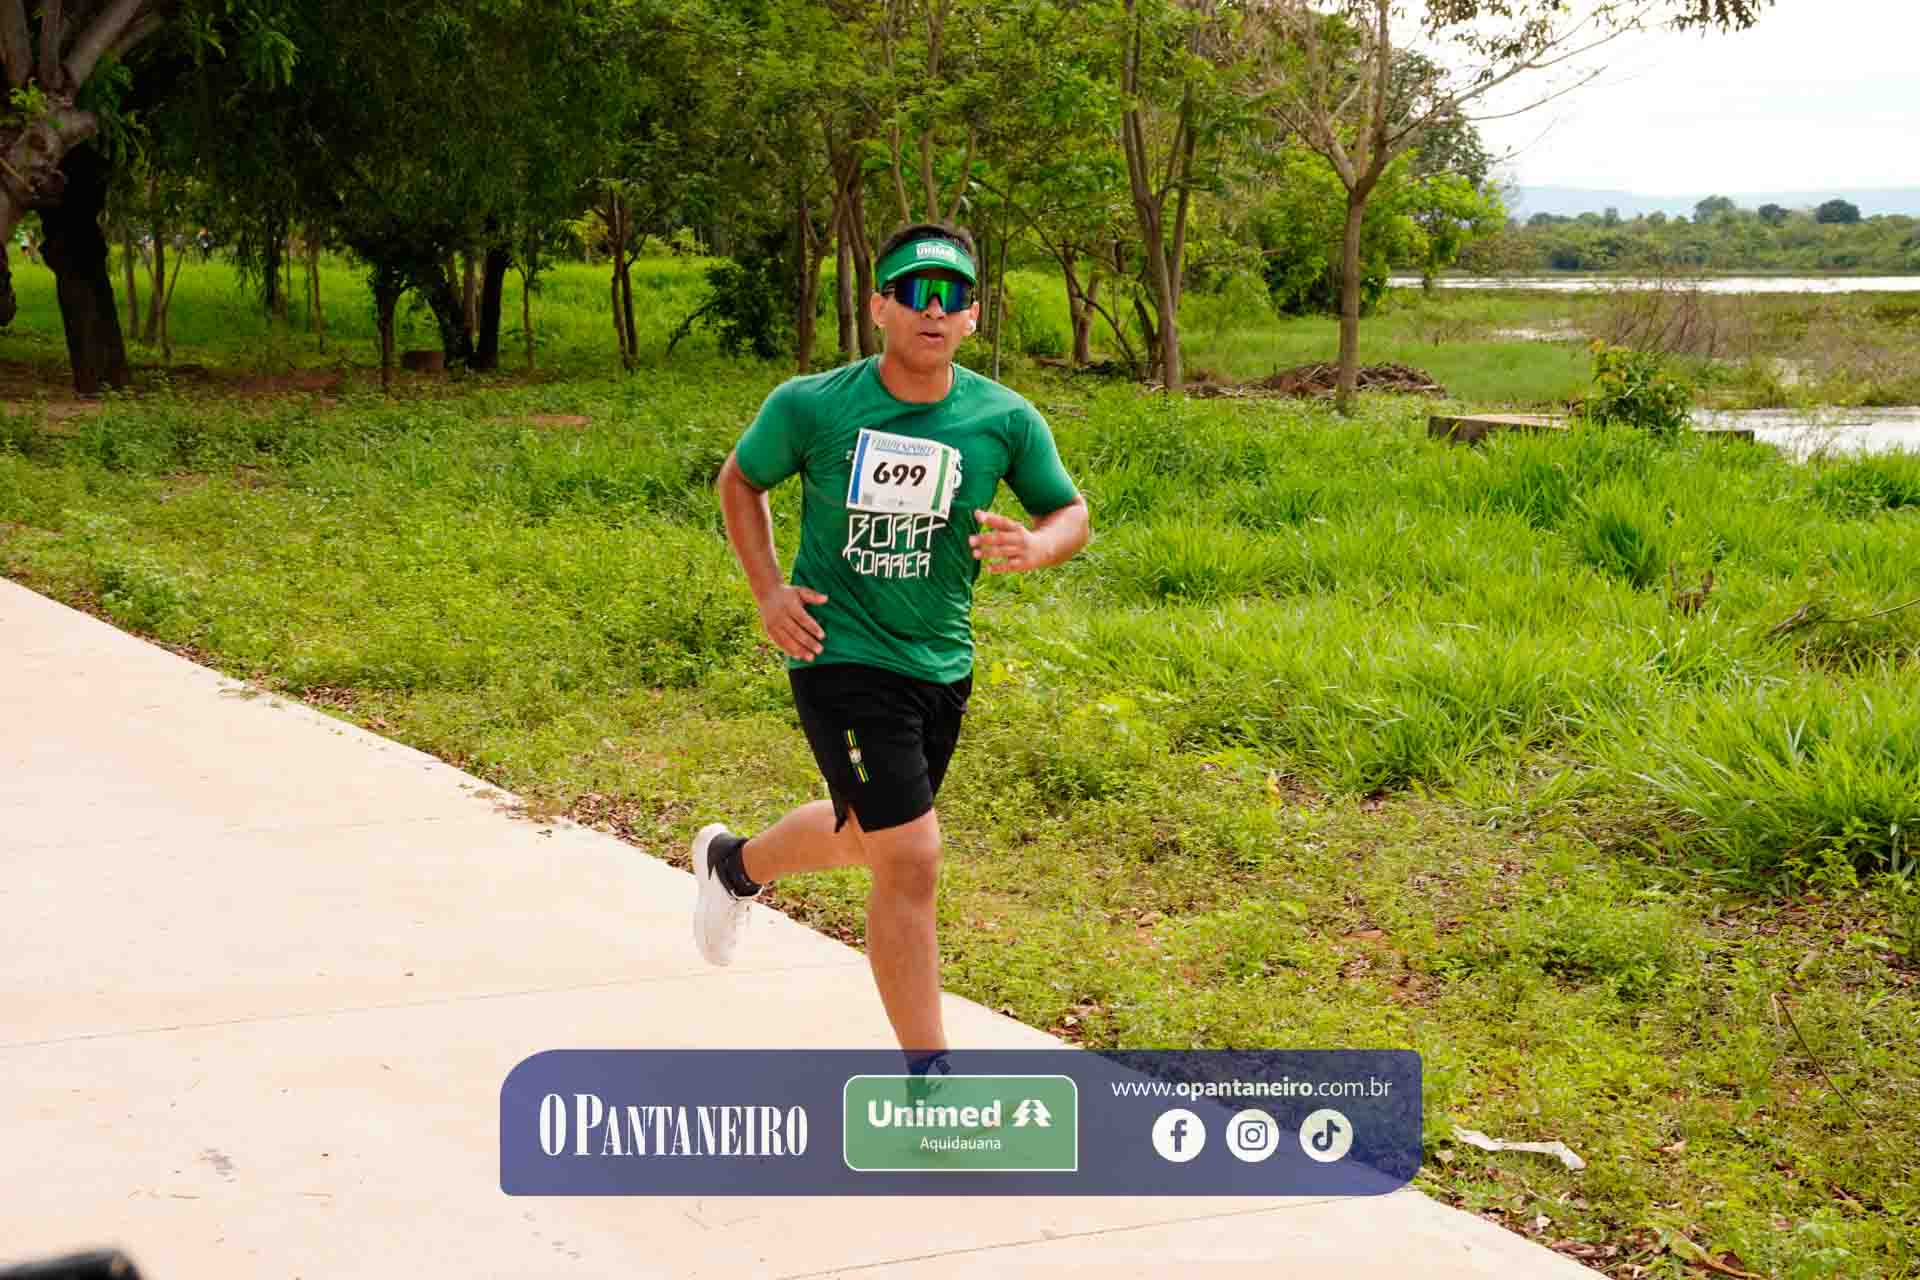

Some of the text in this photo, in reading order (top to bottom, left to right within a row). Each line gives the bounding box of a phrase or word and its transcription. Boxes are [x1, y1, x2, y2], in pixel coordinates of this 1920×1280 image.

[873, 462, 926, 486] 699
[848, 513, 946, 550] BORA
[846, 547, 931, 579] CORRER
